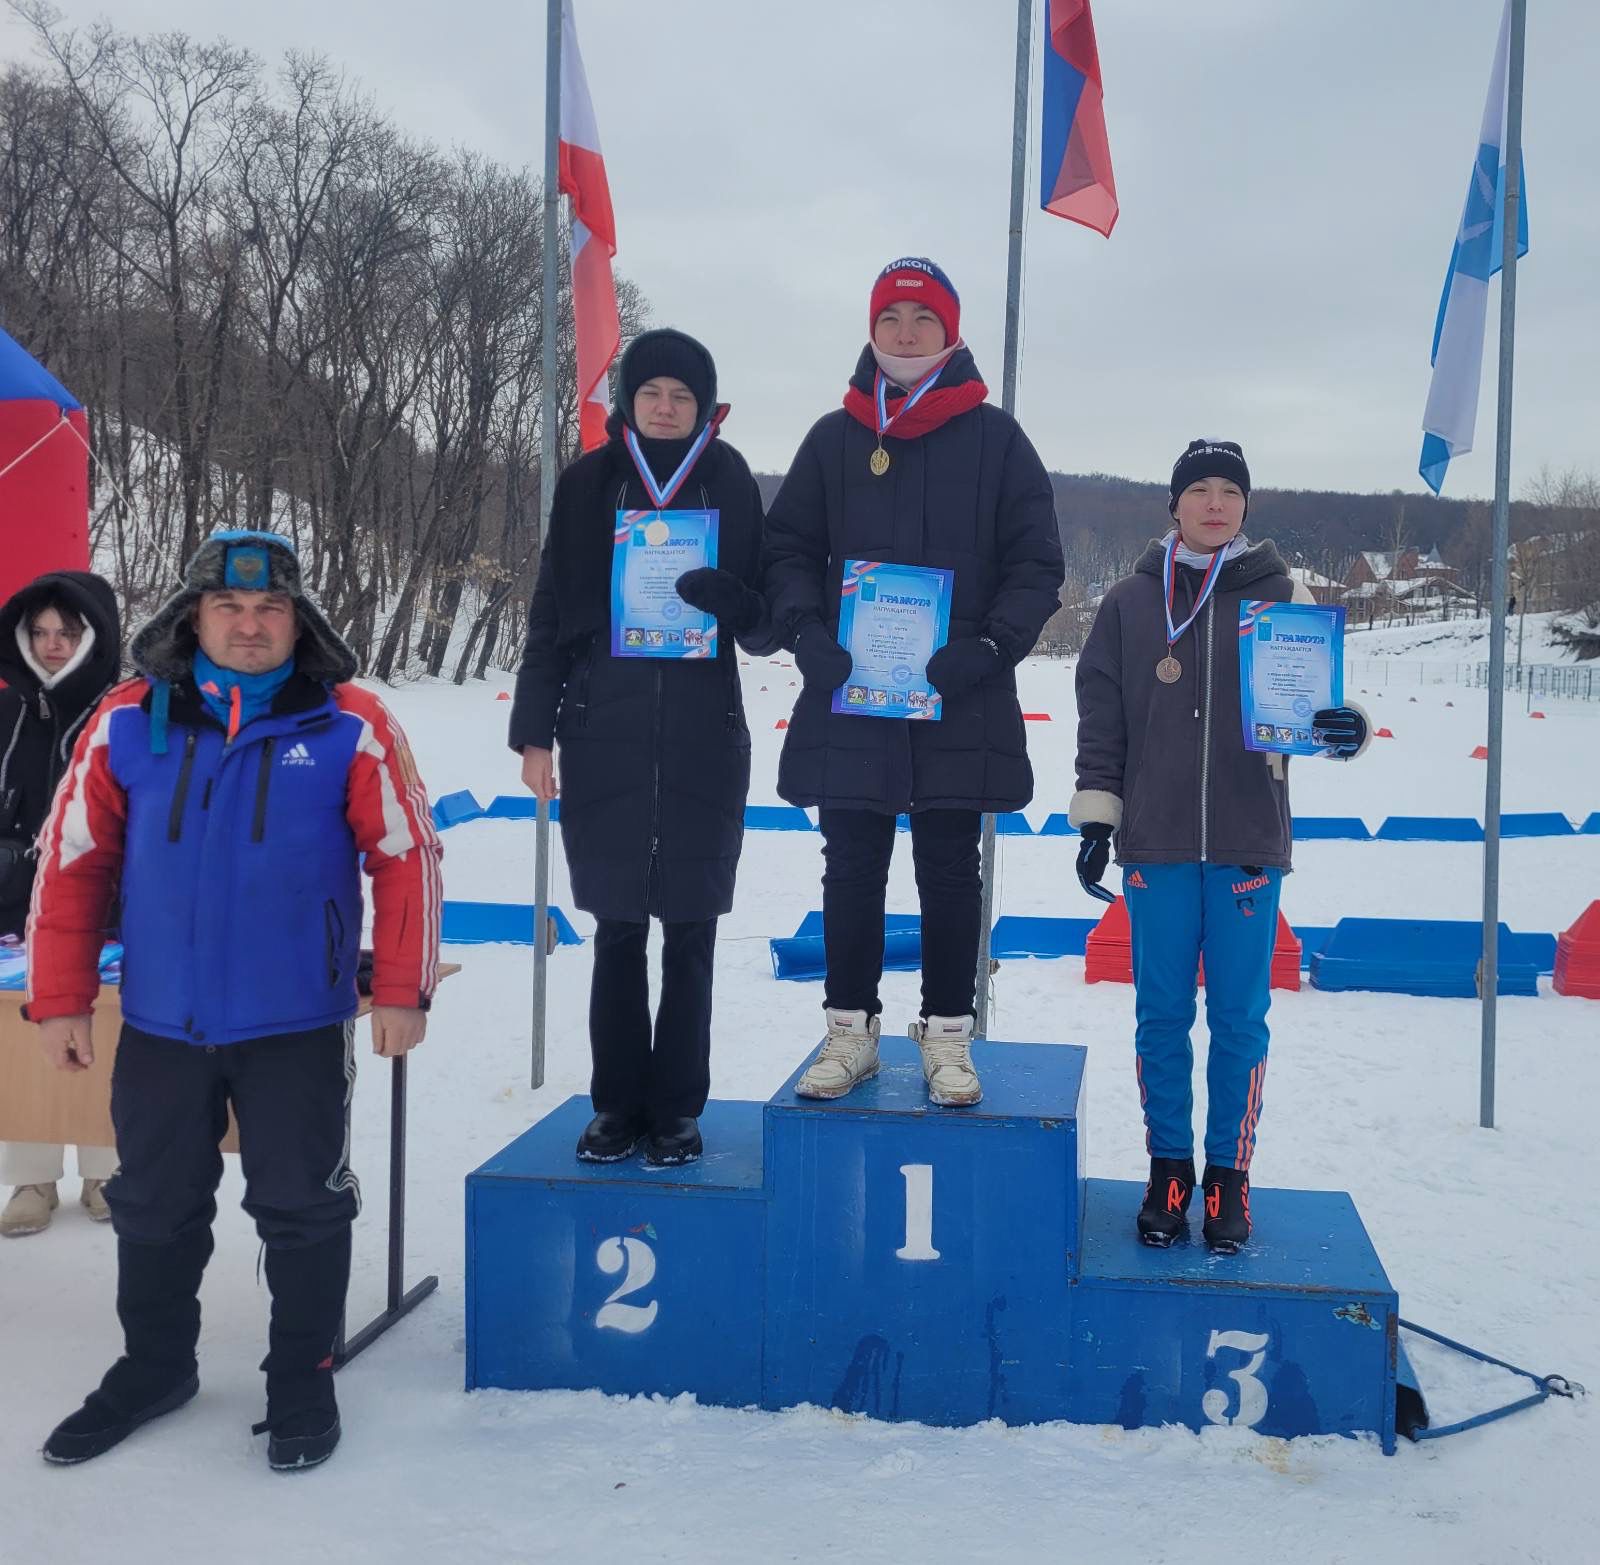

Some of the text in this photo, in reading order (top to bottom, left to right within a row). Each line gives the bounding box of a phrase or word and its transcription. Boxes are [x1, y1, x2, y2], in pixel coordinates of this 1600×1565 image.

[885, 259, 934, 275] LUKOIL
[879, 594, 932, 608] ГРАМОТА
[1274, 633, 1326, 645] ГРАМОТА
[1231, 874, 1271, 894] LUKOIL
[896, 1164, 941, 1261] 1
[595, 1236, 659, 1334] 2
[1202, 1329, 1270, 1428] 3
